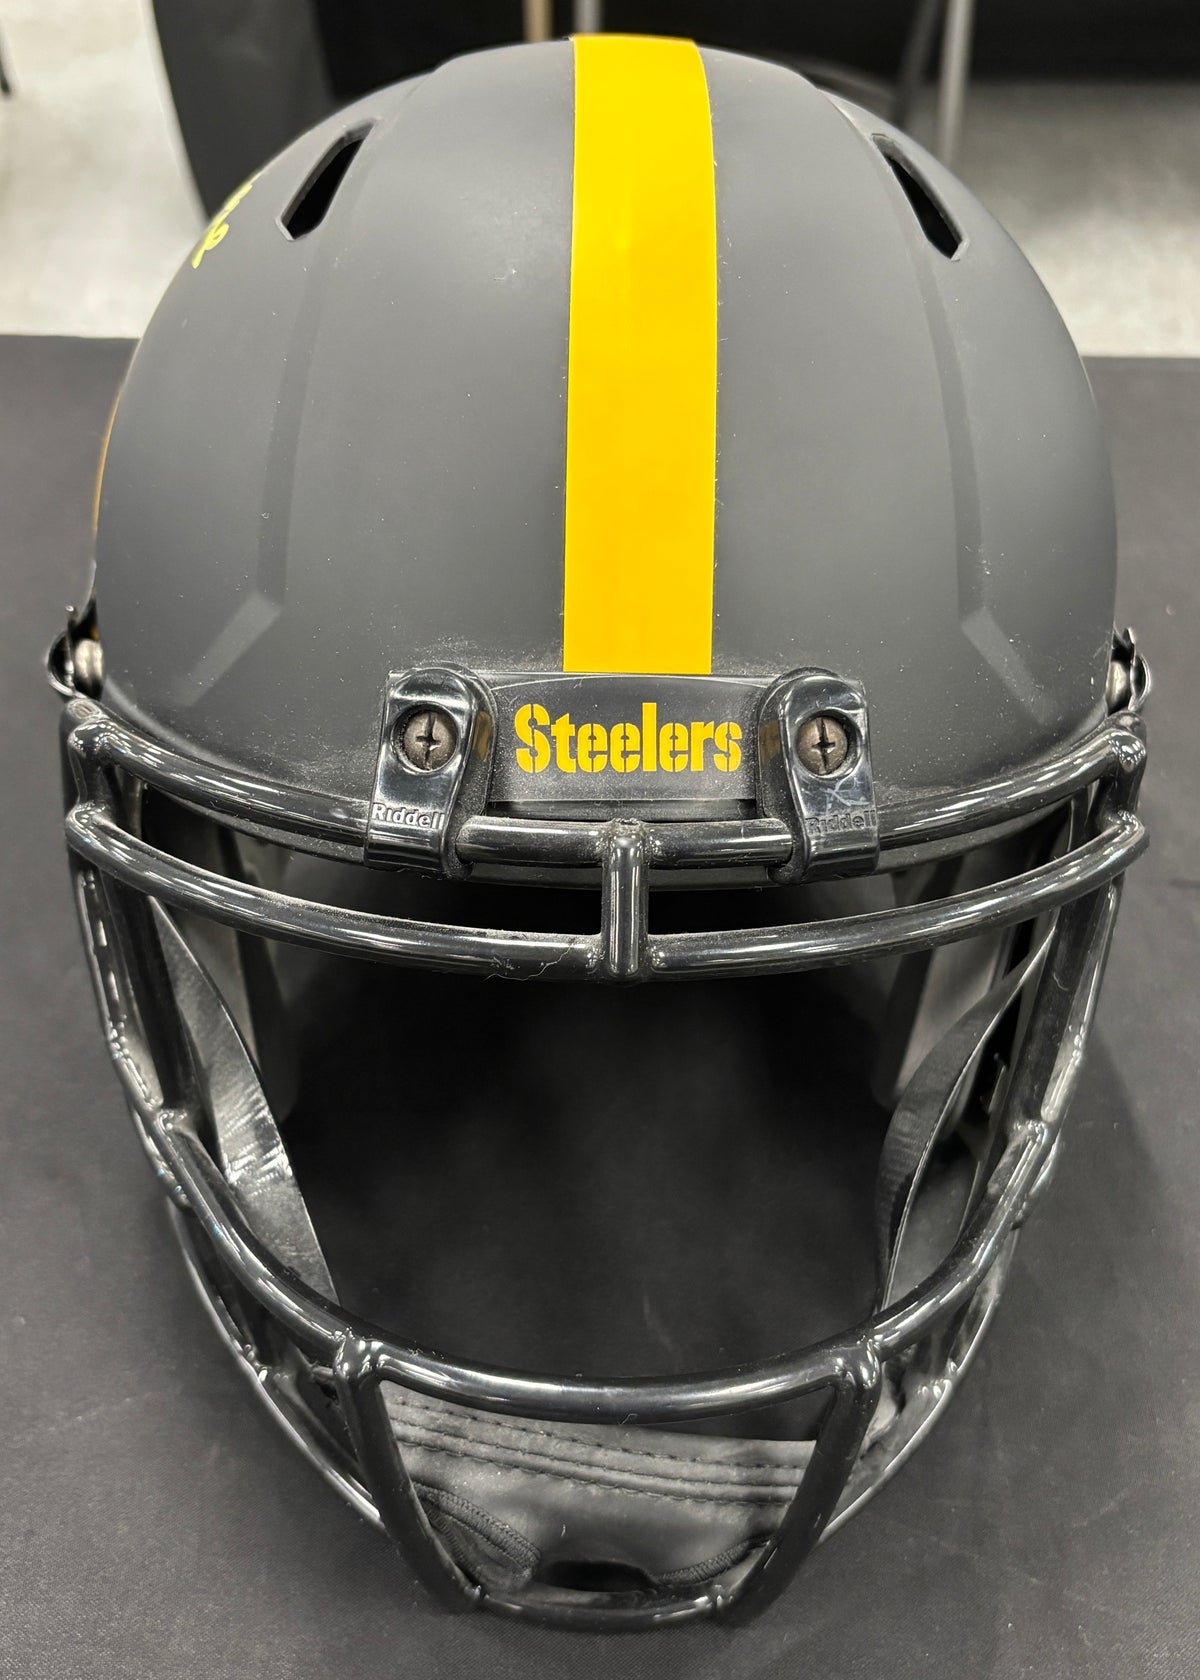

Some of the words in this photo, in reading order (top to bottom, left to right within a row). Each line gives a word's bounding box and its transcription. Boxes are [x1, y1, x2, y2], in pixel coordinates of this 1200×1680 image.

[514, 702, 743, 773] Steelers
[371, 802, 445, 830] Riddell
[804, 809, 876, 836] Riddell
